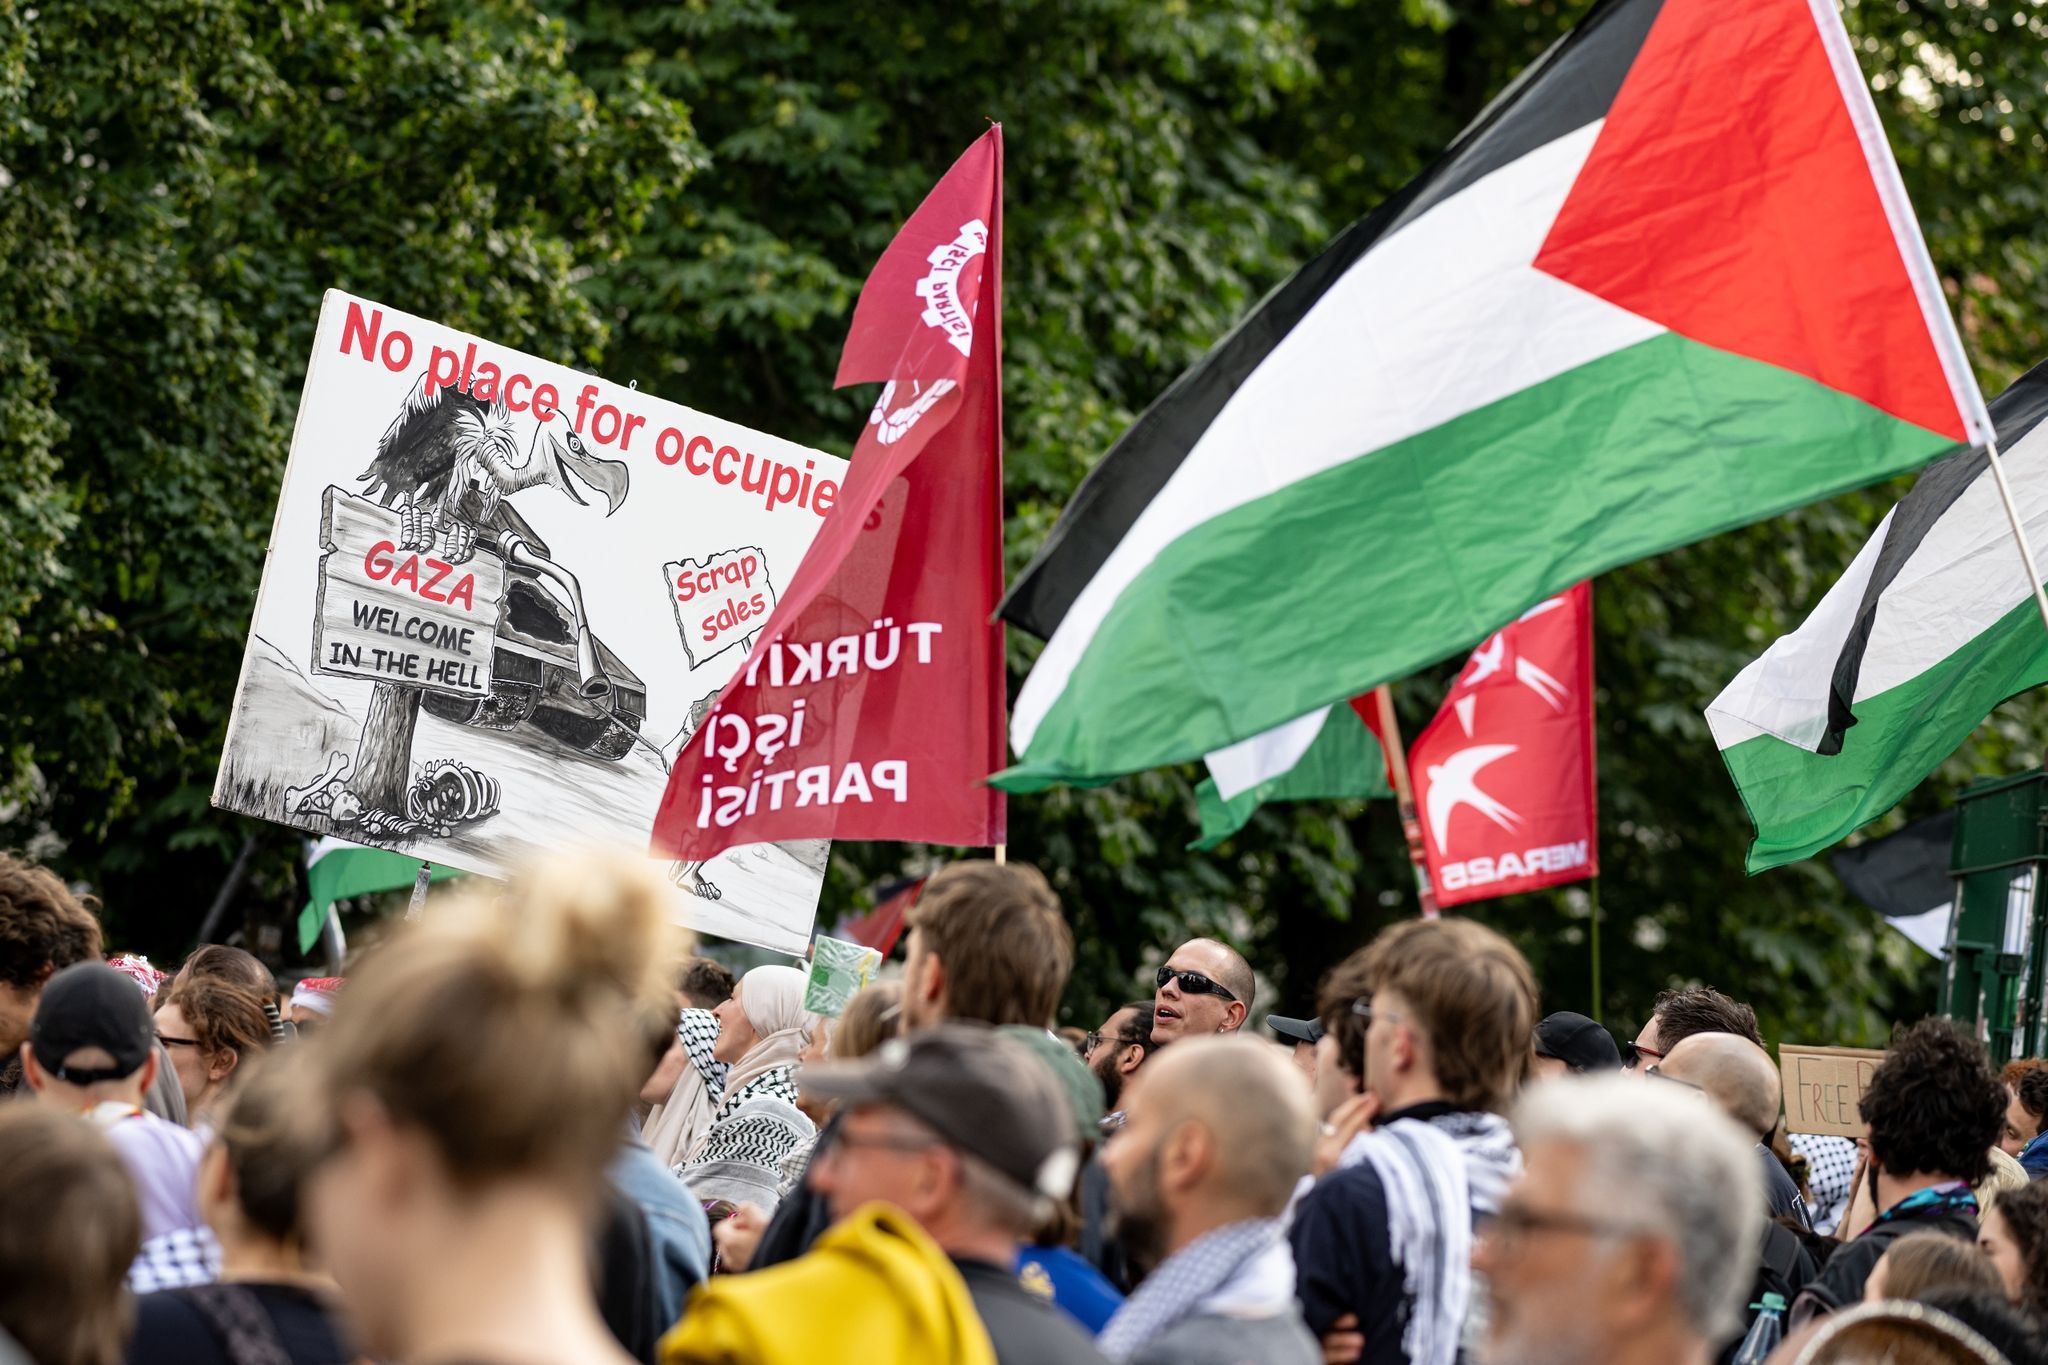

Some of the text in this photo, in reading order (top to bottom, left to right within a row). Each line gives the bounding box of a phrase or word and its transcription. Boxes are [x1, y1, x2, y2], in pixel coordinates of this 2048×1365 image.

[339, 301, 414, 373] No
[423, 341, 560, 423] place
[573, 384, 647, 451] for
[363, 540, 475, 611] GAZA
[677, 555, 757, 601] Scrap
[353, 599, 475, 656] WELCOME
[702, 592, 766, 641] sales
[329, 642, 482, 690] IN THE HELL
[1797, 1056, 1852, 1125] FREE
